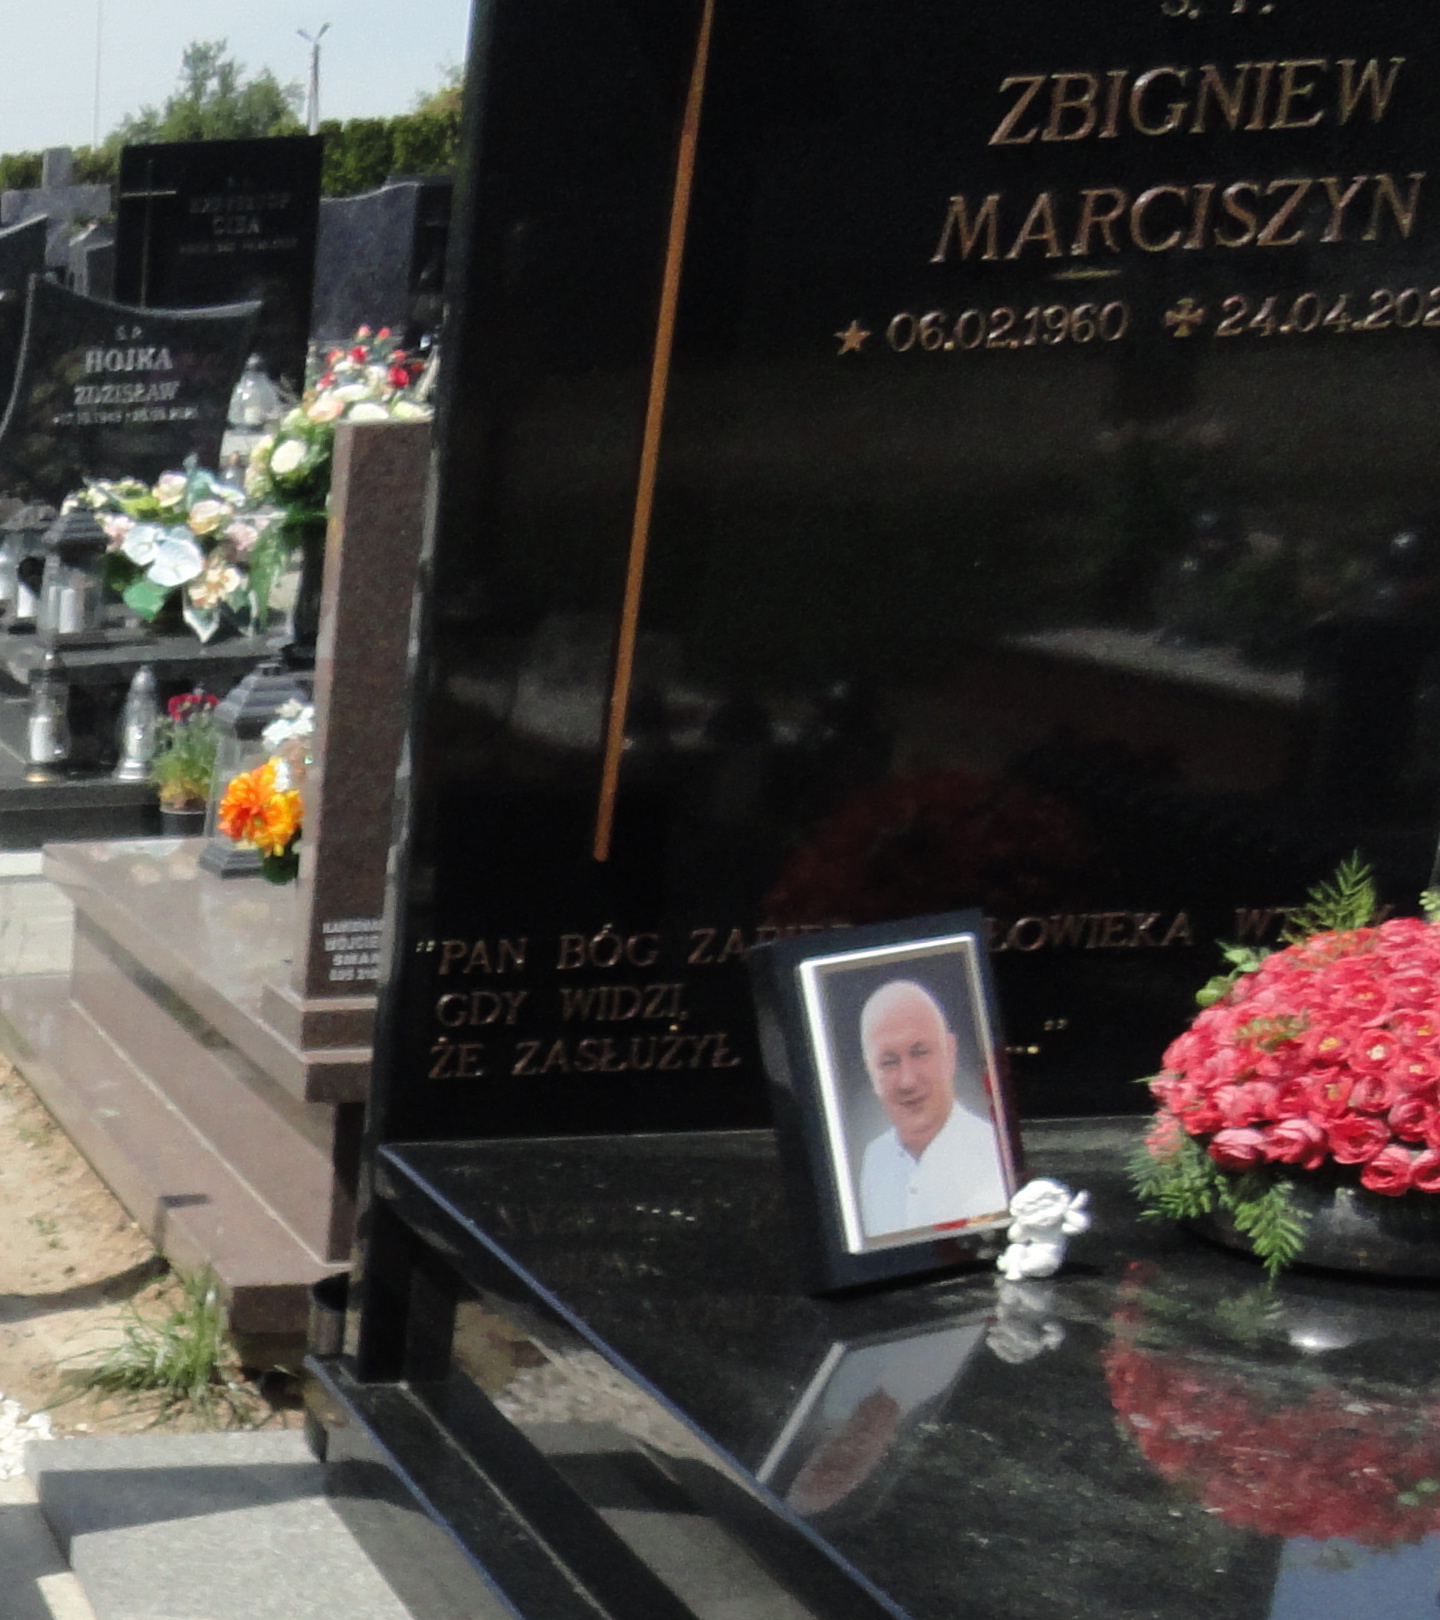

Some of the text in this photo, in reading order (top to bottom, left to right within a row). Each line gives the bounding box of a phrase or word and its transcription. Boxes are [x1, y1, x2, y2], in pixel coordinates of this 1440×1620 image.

[987, 56, 1406, 146] ZBIGNIEW
[929, 171, 1426, 263] MARCISZYN
[885, 302, 1129, 352] 06.02.1960
[556, 922, 661, 971] BÓG
[433, 990, 530, 1028] GDY
[427, 1023, 744, 1079] ŻE ZASŁUŻYŁ
